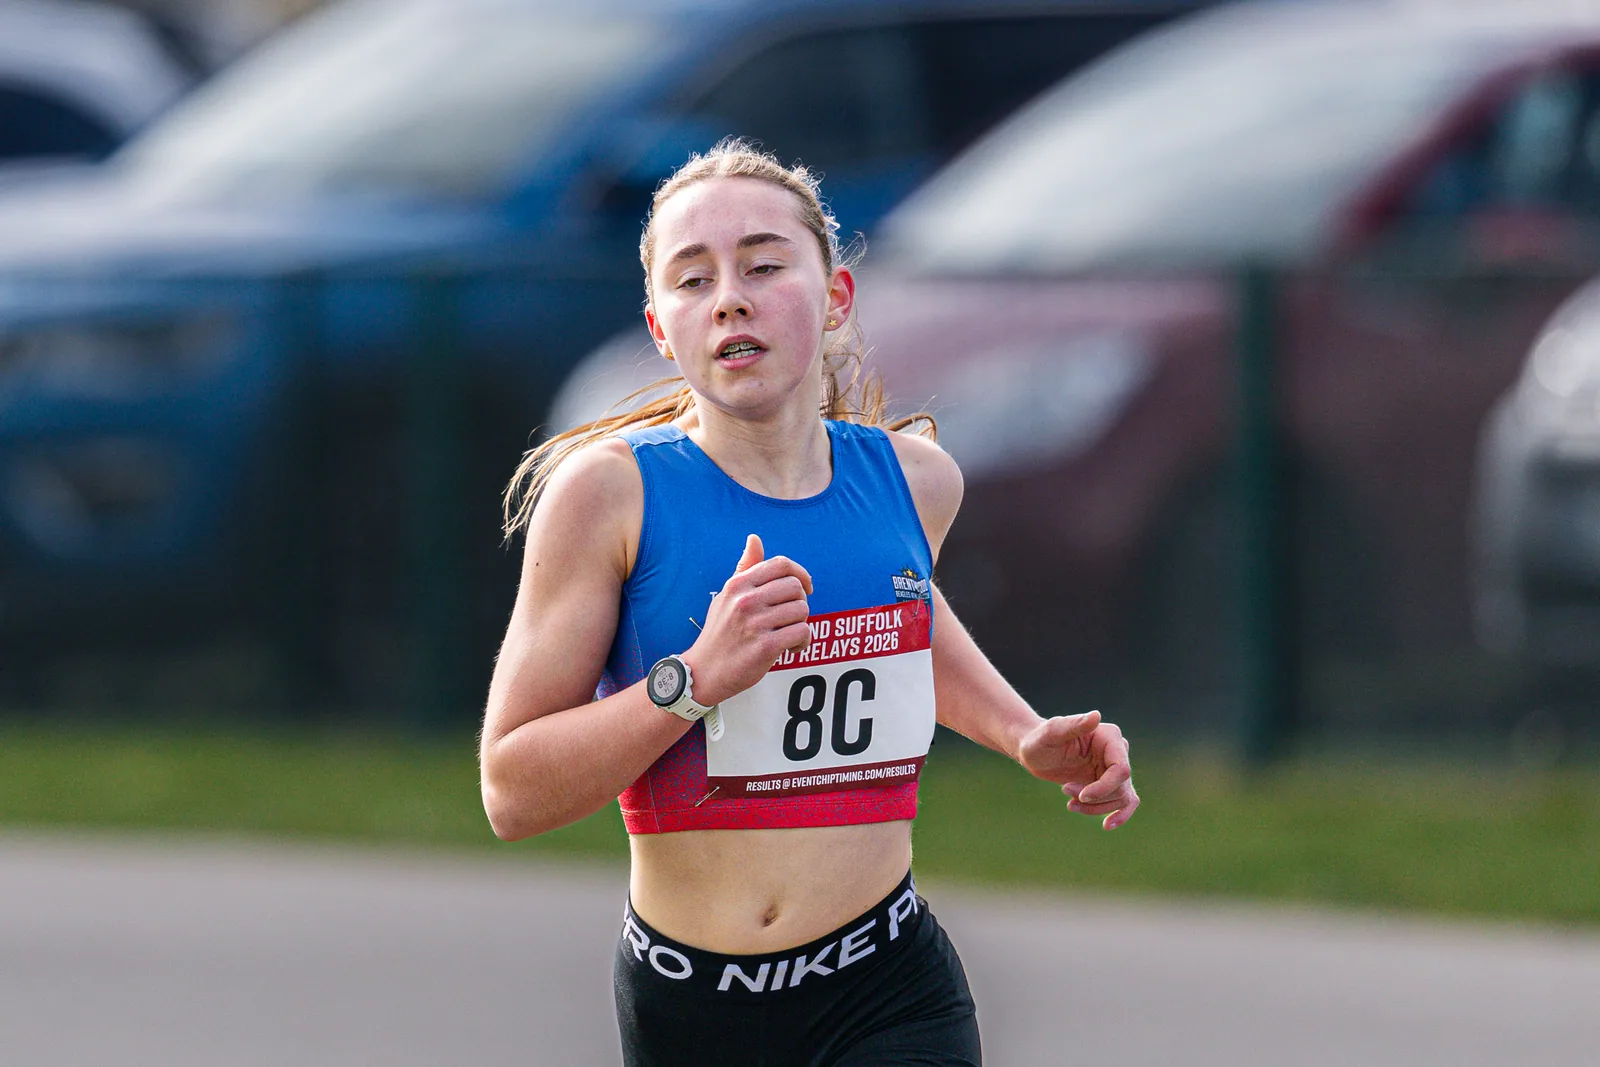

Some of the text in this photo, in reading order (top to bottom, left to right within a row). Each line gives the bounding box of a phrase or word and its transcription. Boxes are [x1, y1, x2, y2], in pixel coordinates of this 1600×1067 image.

[809, 609, 903, 640] ND SUFFOLK
[799, 637, 861, 663] RELAYS
[863, 631, 899, 654] 2026
[782, 668, 876, 762] 8C
[746, 764, 916, 792] RESULTS @ EVENTCHIPTIMING.COM/RESULTS
[622, 899, 693, 980] RO
[716, 919, 876, 992] NIKE
